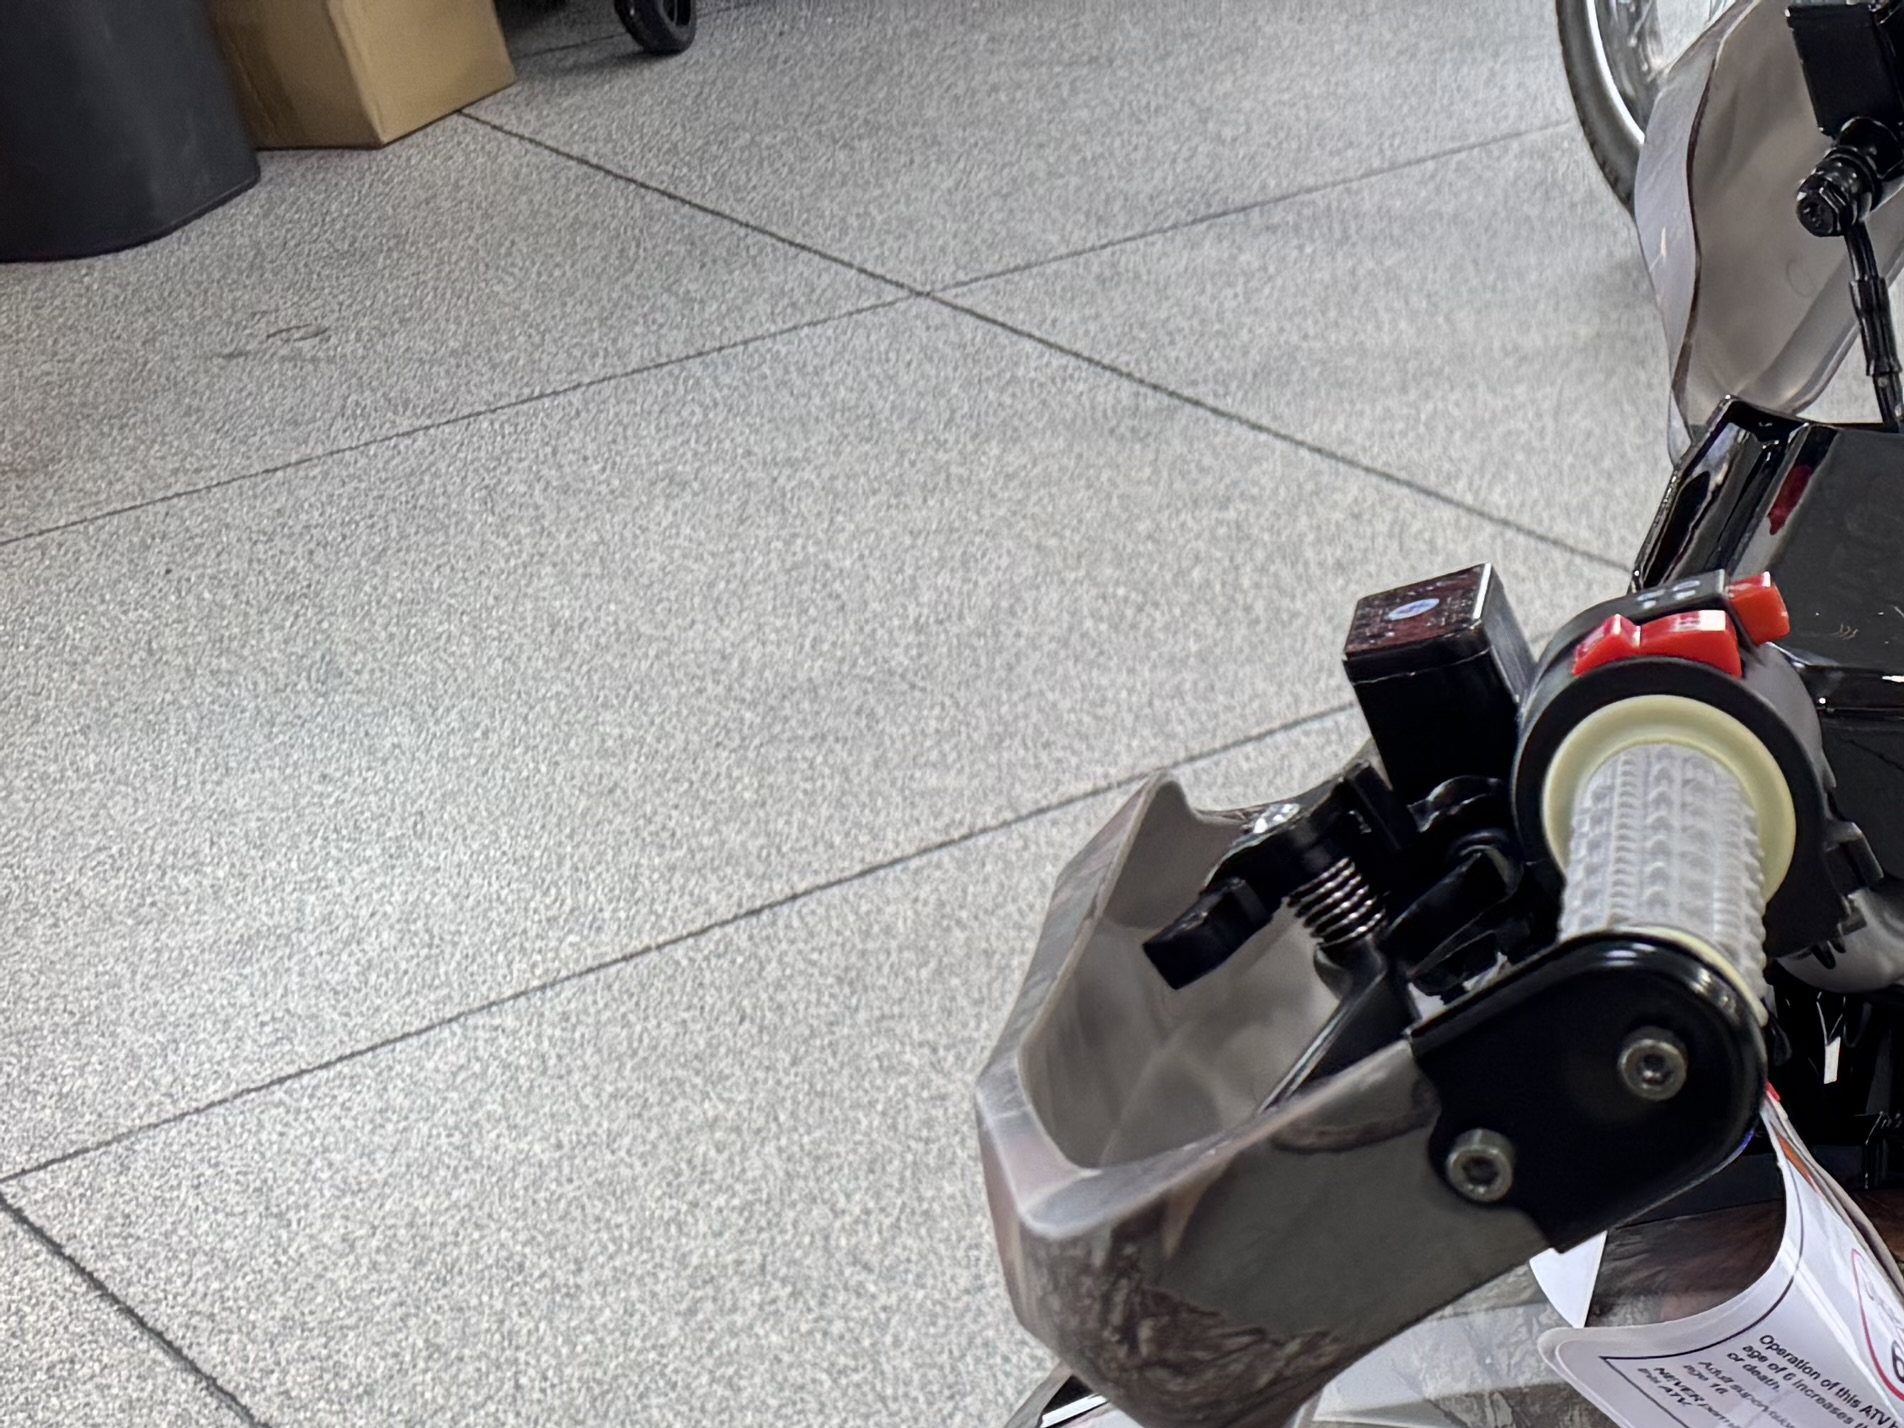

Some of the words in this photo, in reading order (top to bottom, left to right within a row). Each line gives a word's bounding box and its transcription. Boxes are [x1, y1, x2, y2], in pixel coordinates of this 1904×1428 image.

[1726, 1352, 1745, 1362] or
[1742, 1345, 1768, 1362] age
[1767, 1362, 1787, 1373] of
[1792, 1379, 1853, 1424] increases
[1759, 1334, 1820, 1379] Operation
[1820, 1379, 1840, 1390] of
[1834, 1387, 1861, 1408] this
[1858, 1404, 1891, 1425] ATV
